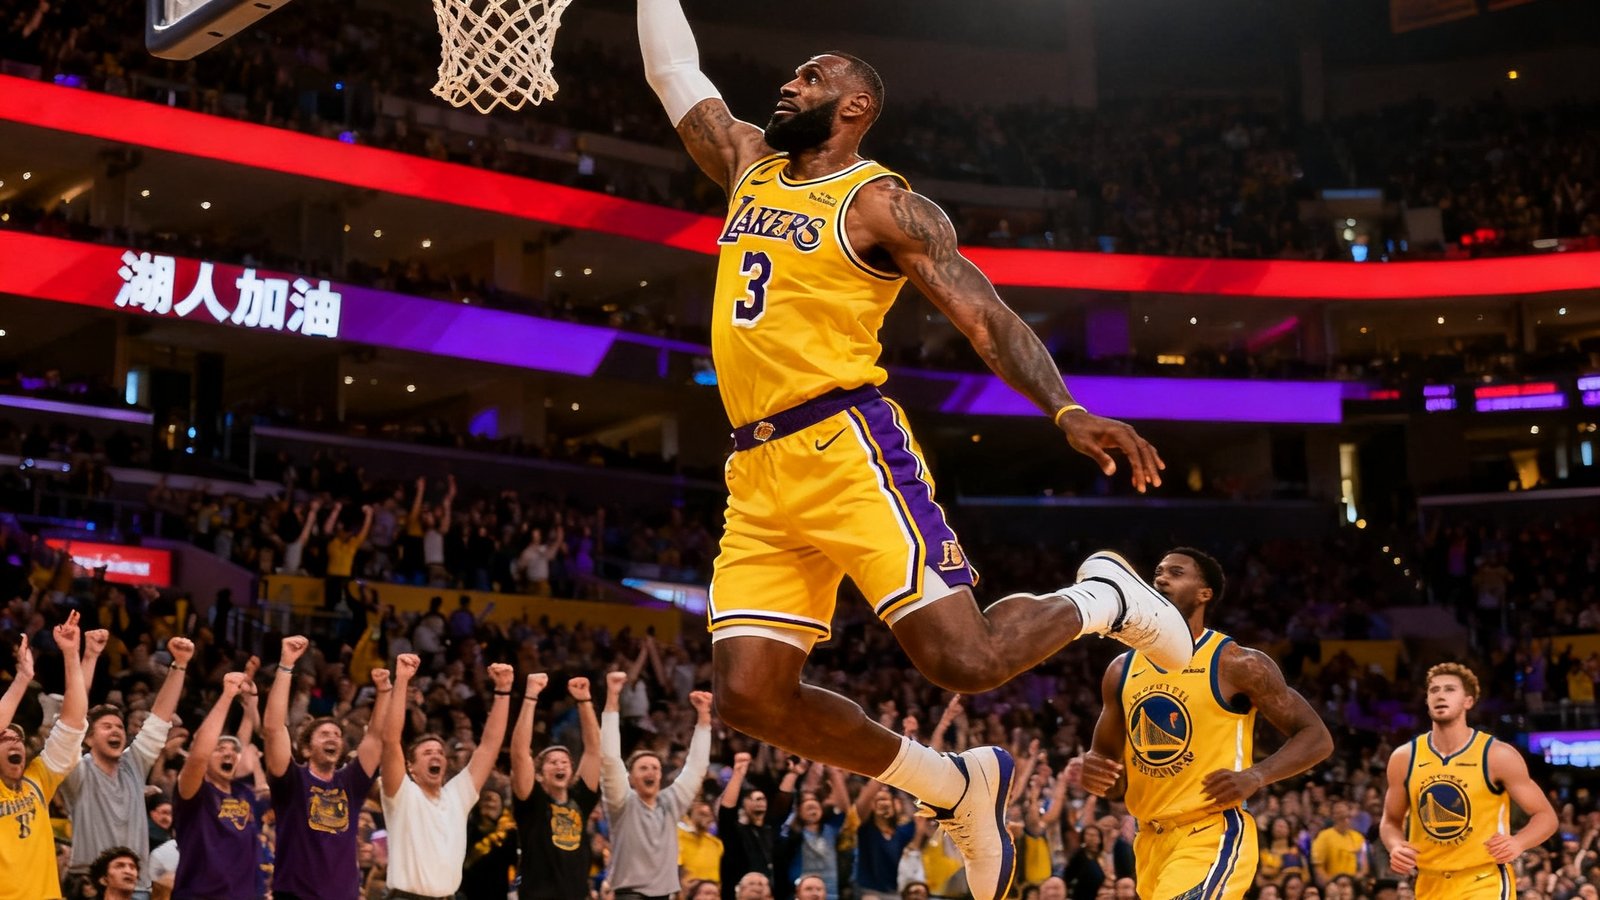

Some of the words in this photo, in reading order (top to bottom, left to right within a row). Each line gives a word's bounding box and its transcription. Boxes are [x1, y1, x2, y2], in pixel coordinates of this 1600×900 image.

[717, 195, 827, 253] LAKERS
[114, 250, 342, 338] 湖人加油
[732, 250, 773, 328] 3
